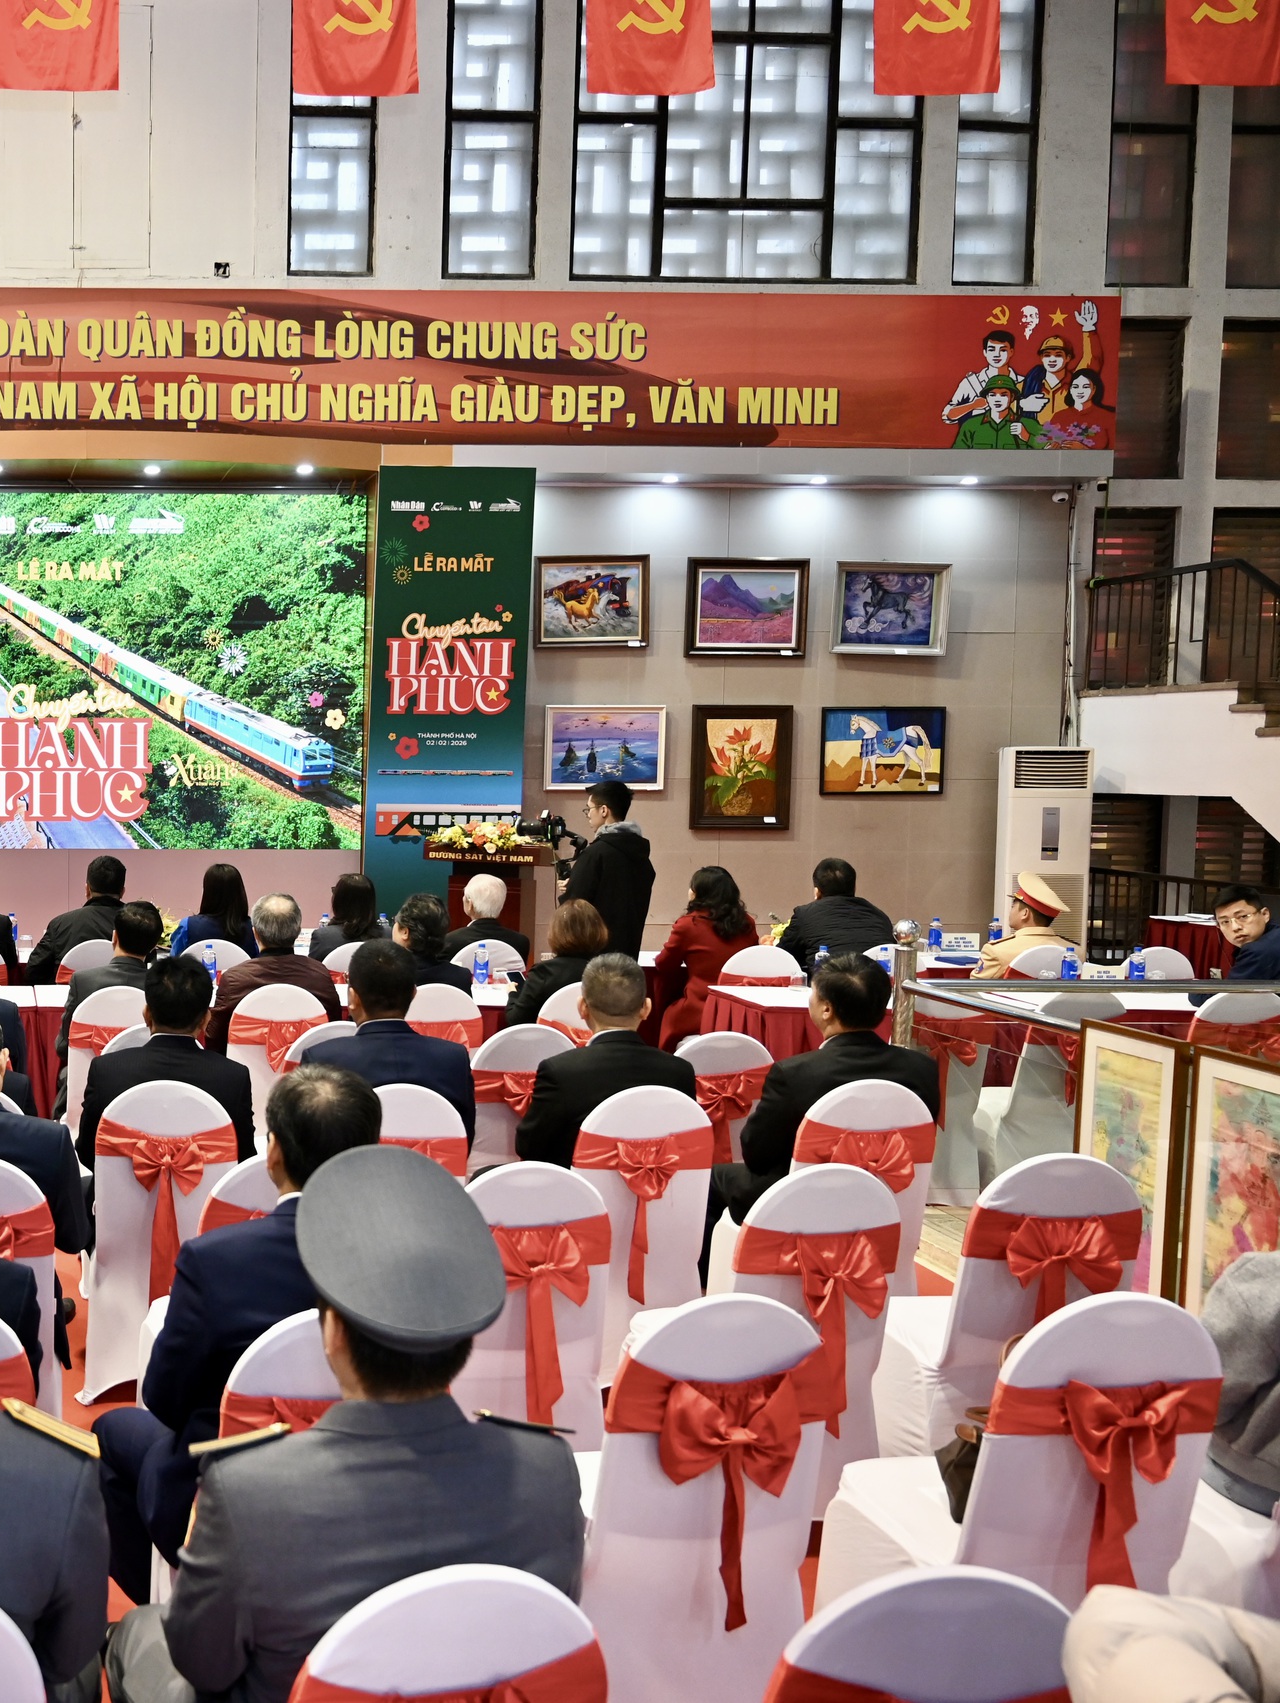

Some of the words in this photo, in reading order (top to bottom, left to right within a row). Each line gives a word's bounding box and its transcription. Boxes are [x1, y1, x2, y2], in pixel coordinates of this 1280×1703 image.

[78, 312, 184, 362] QUÂN
[195, 305, 302, 359] ĐỒNG
[315, 311, 415, 359] LÒNG
[427, 321, 558, 361] CHUNG
[571, 311, 646, 361] SỨC
[90, 375, 143, 421] XÃ
[155, 375, 218, 429] HỘI
[231, 367, 308, 421] CHỦ
[321, 376, 439, 423] NGHĨA
[451, 376, 540, 423] GIÀU
[551, 385, 637, 431] ĐẸP,
[650, 378, 726, 425] VĂN
[738, 387, 839, 426] MINH
[45, 561, 74, 581] RA
[413, 552, 434, 572] LỄ
[436, 557, 458, 572] RA
[389, 641, 513, 677] HẠNH
[391, 675, 507, 712] PHÚC
[169, 753, 232, 787] Xuân
